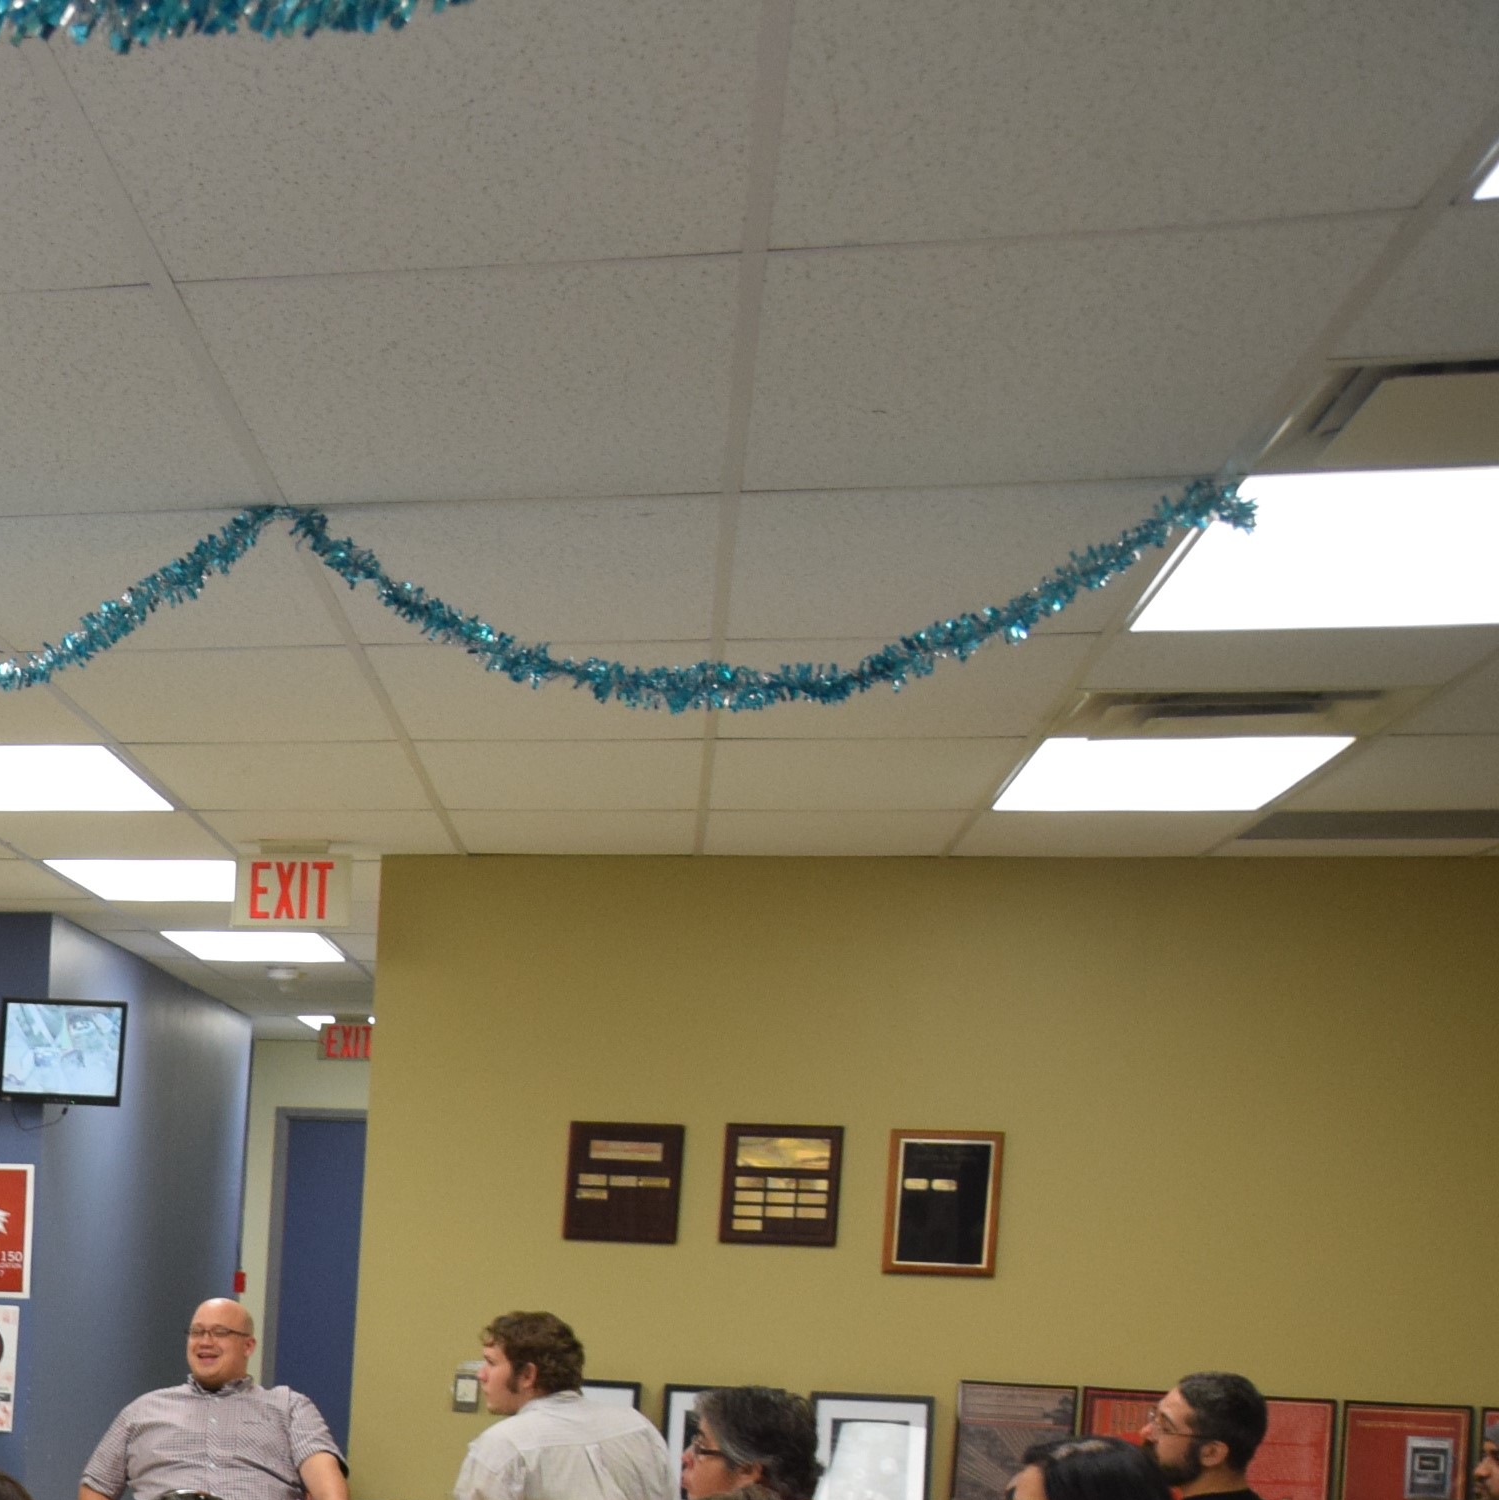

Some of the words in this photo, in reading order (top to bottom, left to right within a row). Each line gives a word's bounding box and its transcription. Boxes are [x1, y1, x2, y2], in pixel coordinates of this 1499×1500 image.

[249, 862, 334, 919] EXIT
[325, 1024, 372, 1058] EXIT
[0, 1250, 23, 1263] 150
